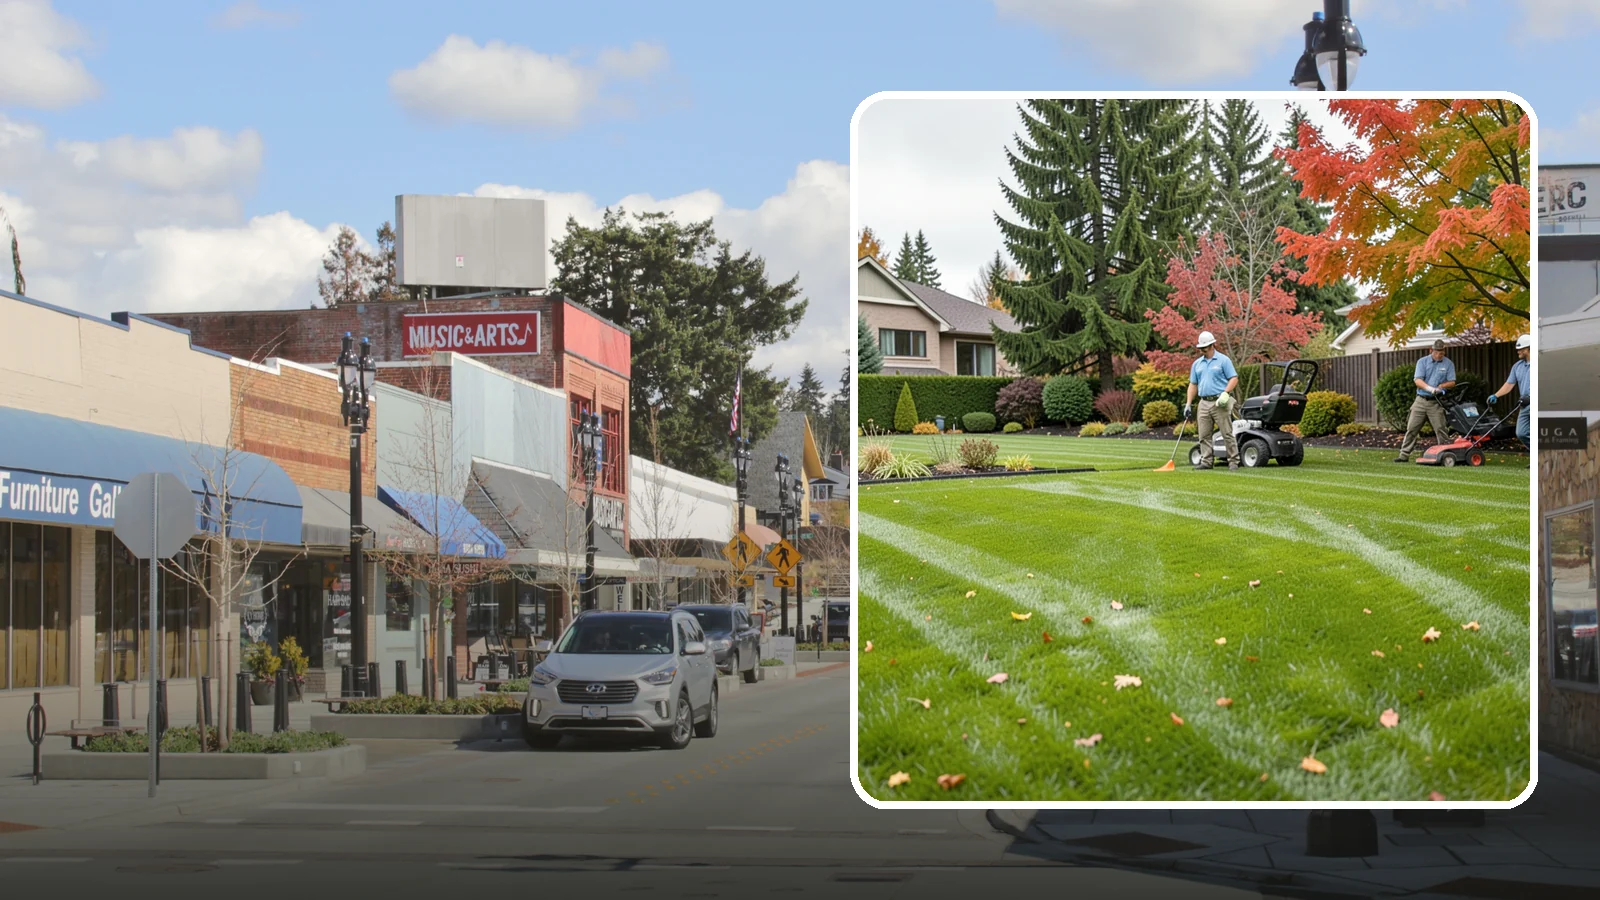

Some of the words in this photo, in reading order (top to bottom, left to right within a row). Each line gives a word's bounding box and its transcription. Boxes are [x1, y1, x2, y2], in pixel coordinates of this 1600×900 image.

[0, 471, 79, 515] Furniture
[89, 482, 122, 520] Gal
[453, 562, 479, 574] SUSHI
